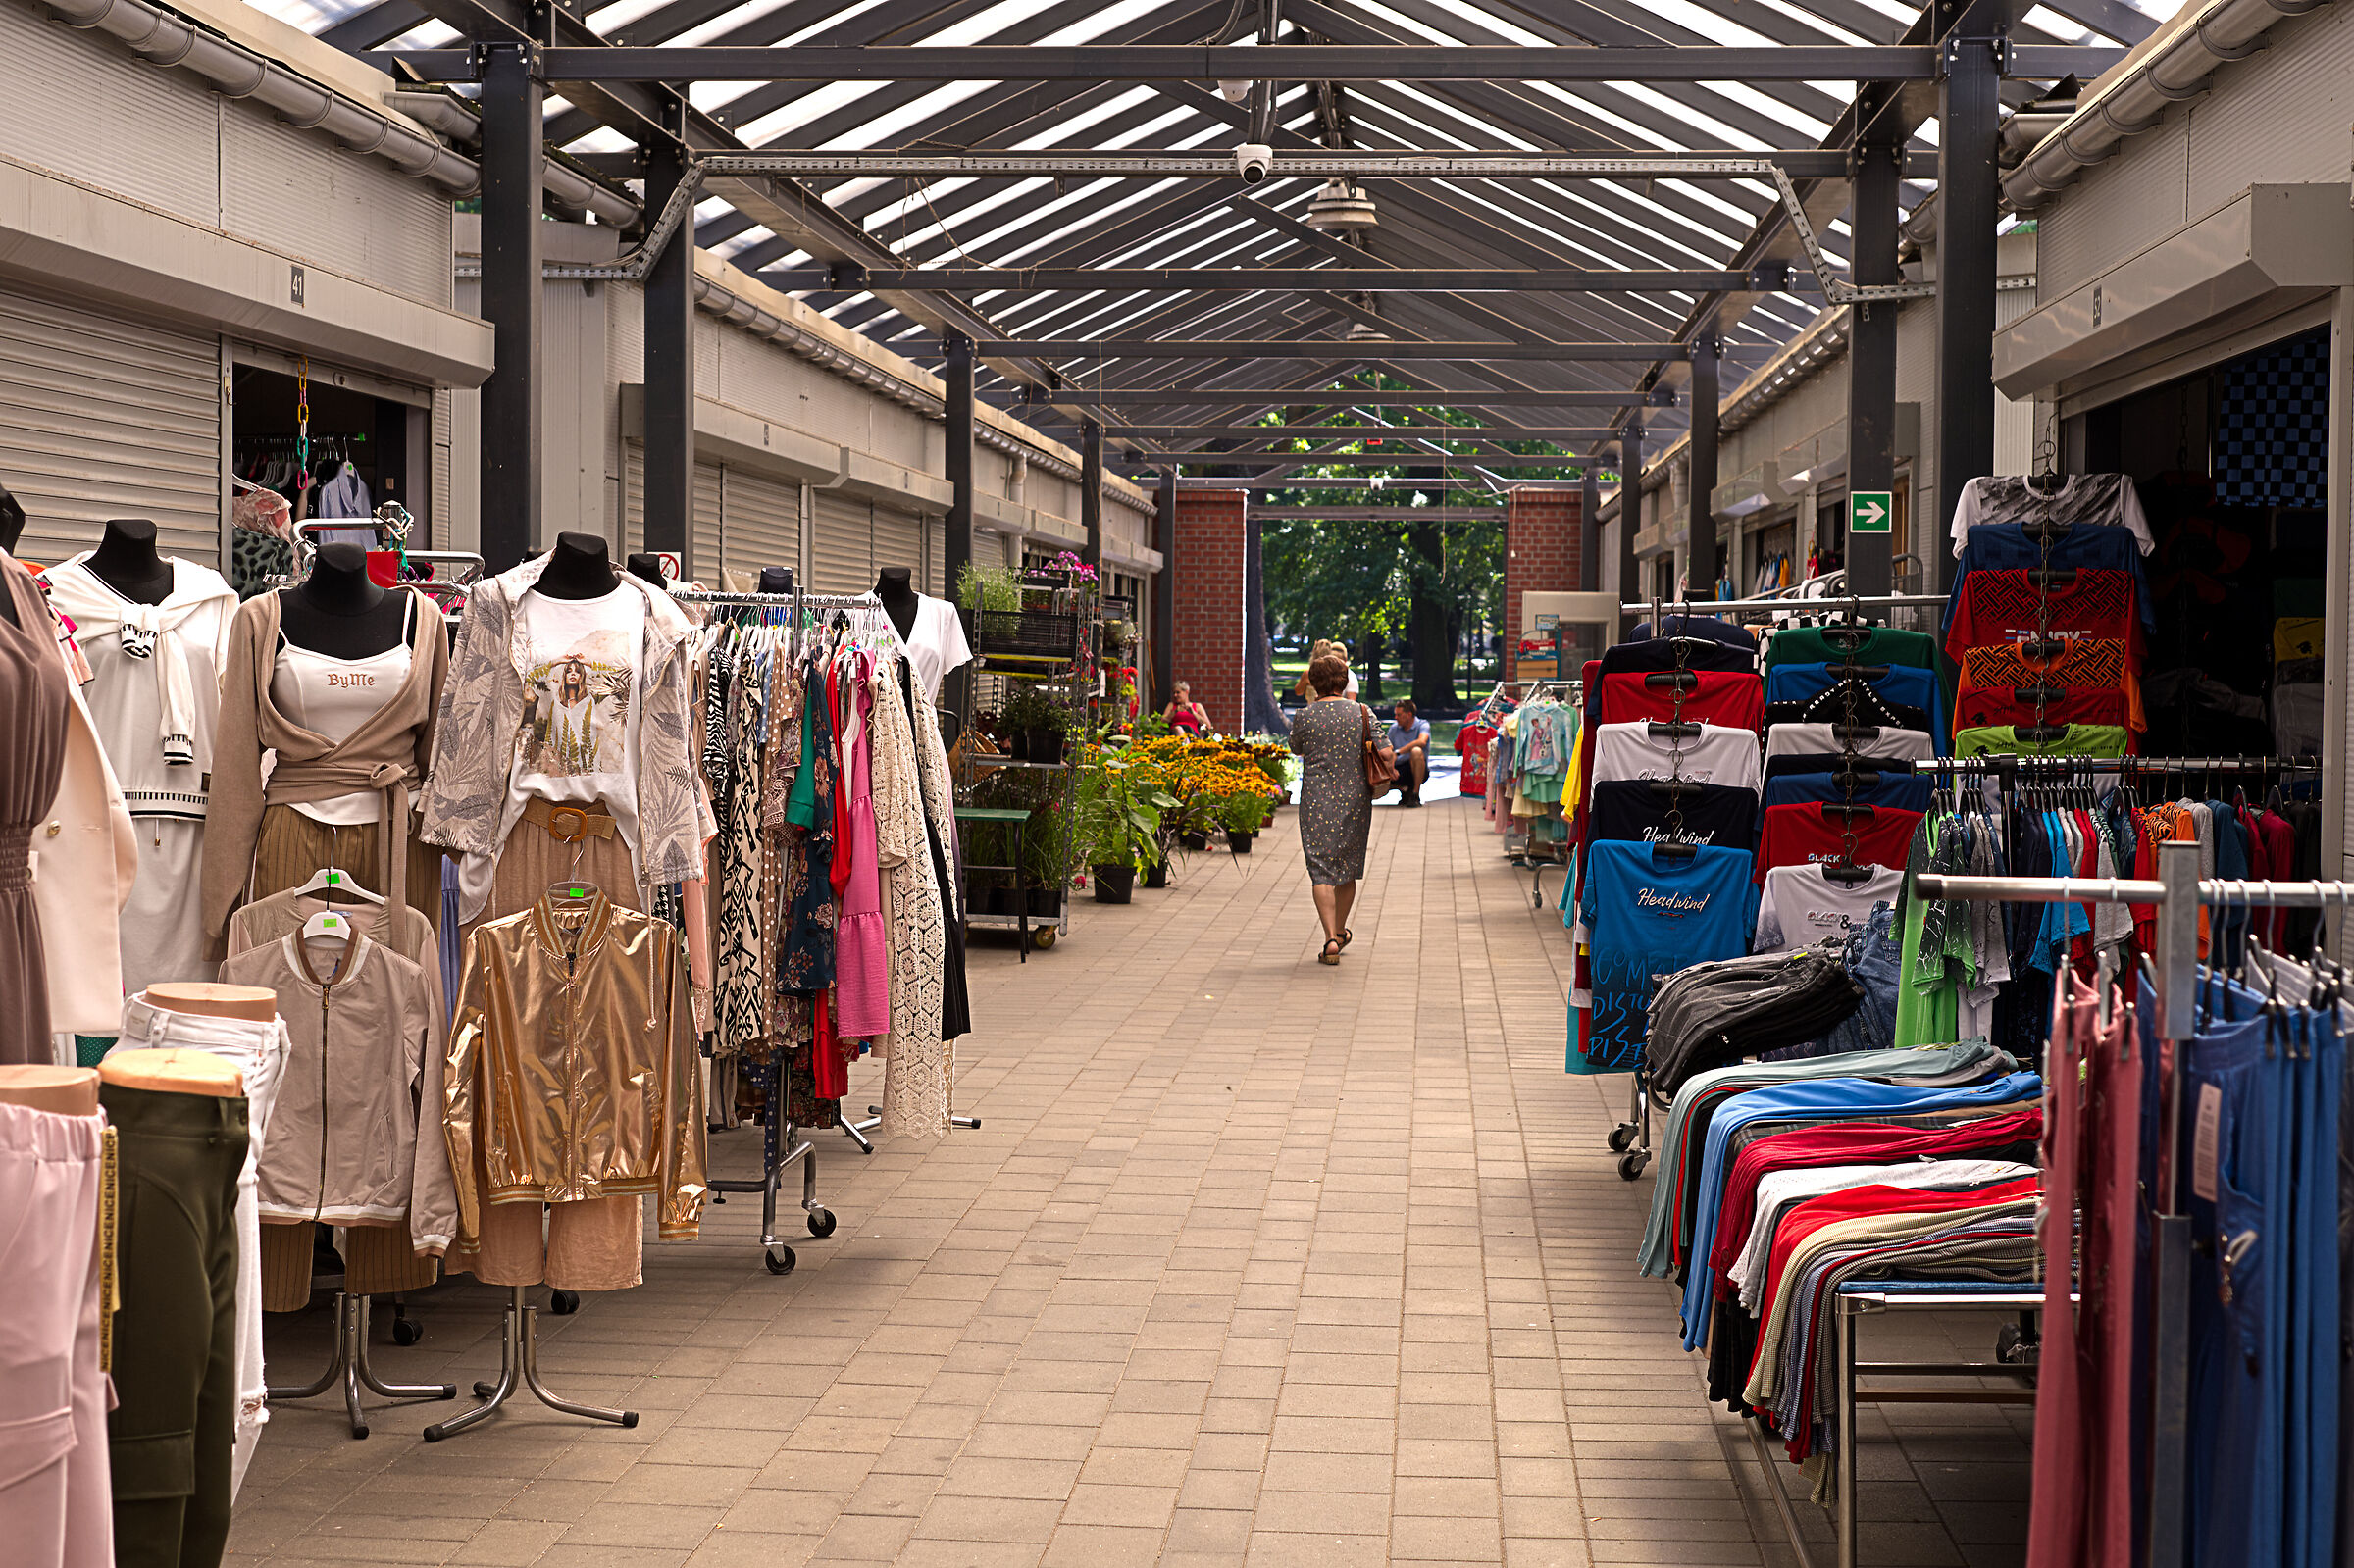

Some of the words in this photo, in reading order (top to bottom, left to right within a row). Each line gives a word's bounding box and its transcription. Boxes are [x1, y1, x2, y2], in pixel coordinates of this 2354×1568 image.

[292, 274, 302, 296] 41
[327, 673, 376, 689] ByMe
[1807, 852, 1841, 863] BLACK
[1637, 887, 1711, 913] Headwind
